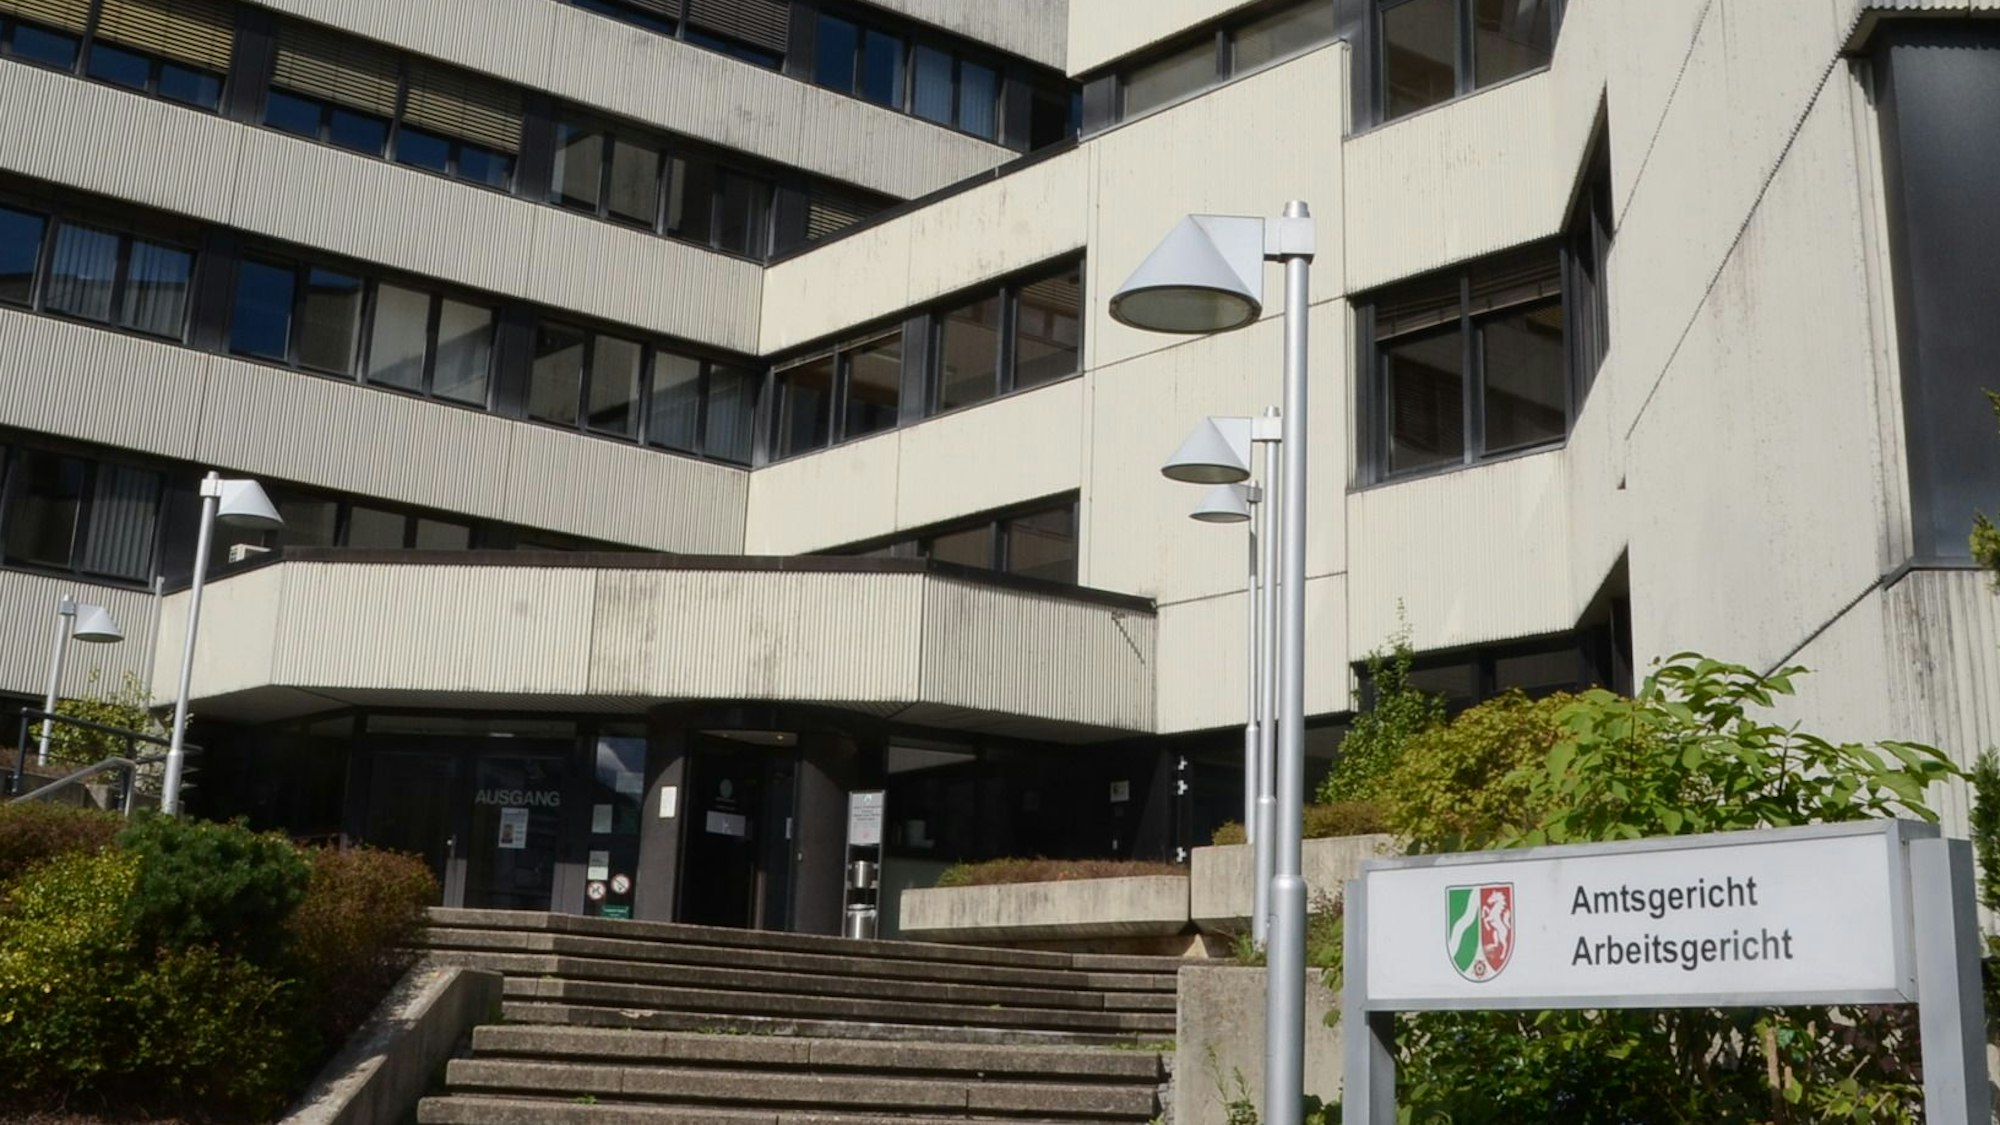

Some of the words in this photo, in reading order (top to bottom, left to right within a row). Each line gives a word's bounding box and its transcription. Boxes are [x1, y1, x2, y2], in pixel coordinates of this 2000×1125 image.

[475, 789, 560, 806] AUSGANG
[1571, 876, 1758, 919] Amtsgericht
[1572, 928, 1793, 971] Arbeitsgericht
